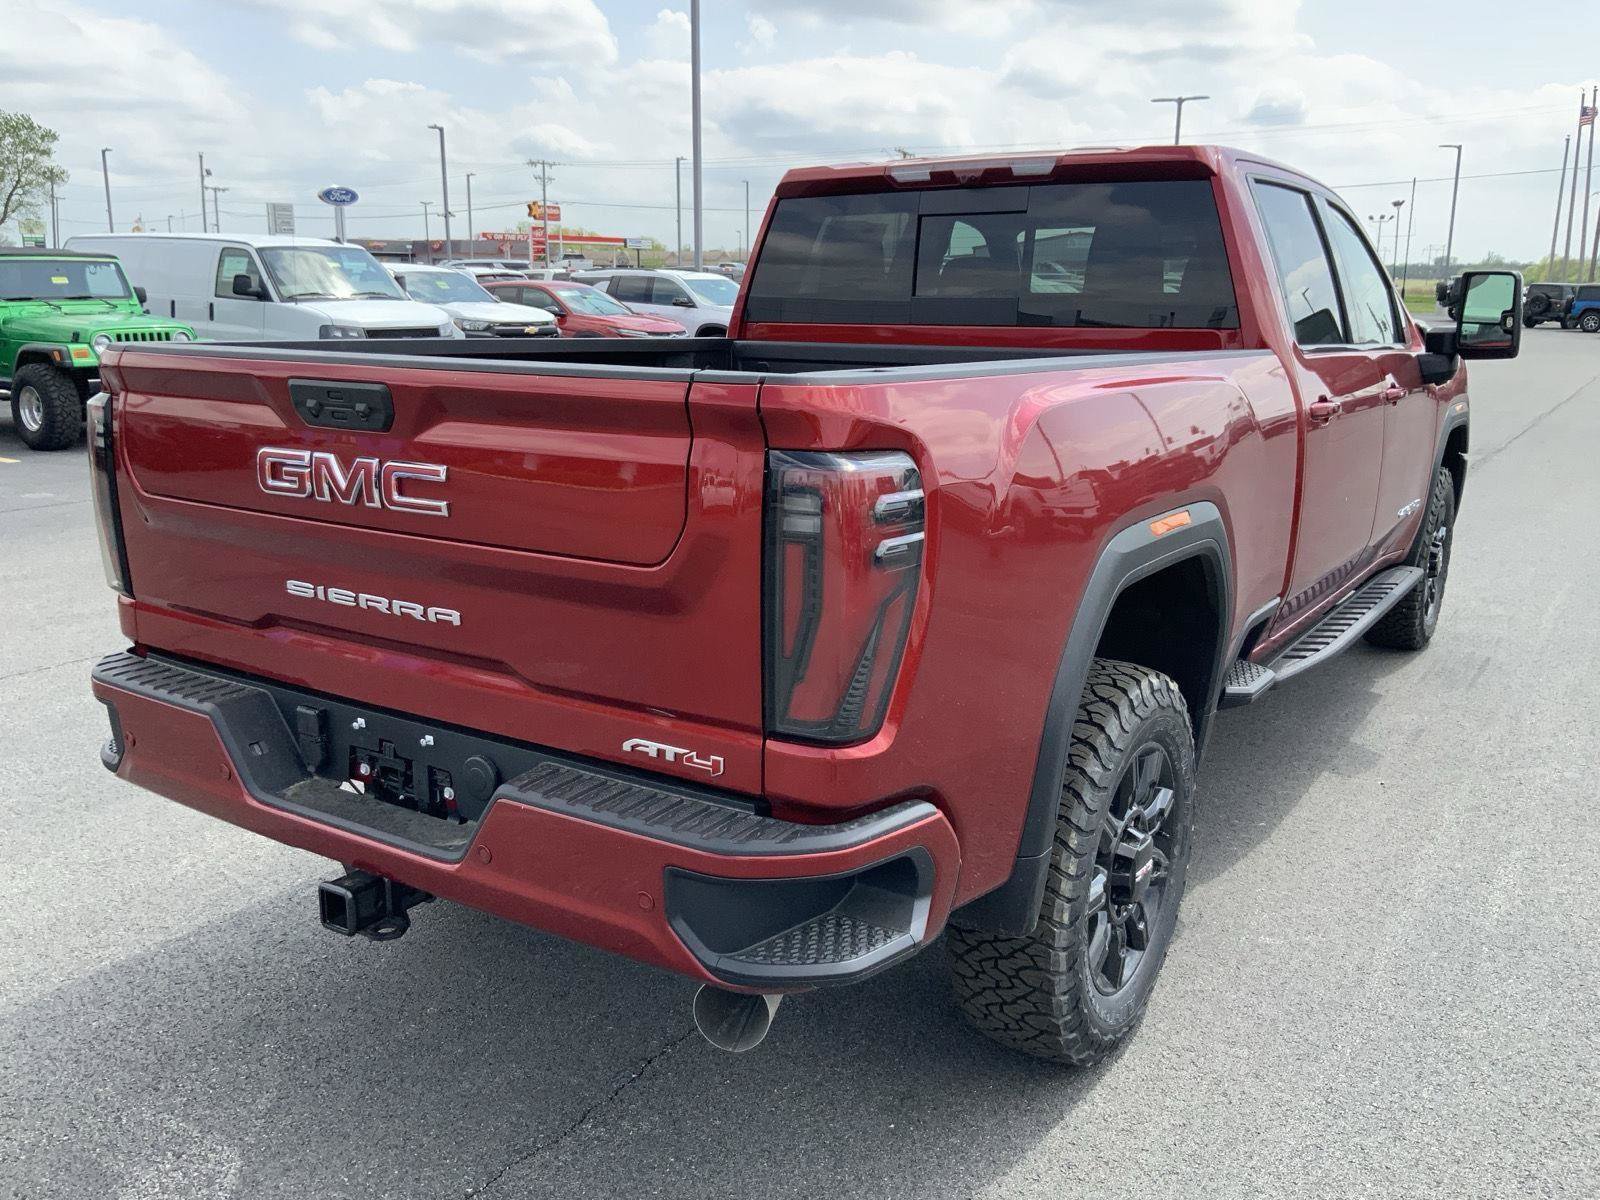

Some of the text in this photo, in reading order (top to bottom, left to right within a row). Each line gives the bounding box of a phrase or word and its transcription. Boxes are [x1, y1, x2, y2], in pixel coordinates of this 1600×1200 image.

[329, 190, 352, 202] Ford
[256, 446, 449, 518] GMC
[286, 579, 462, 626] SIERRA
[622, 738, 725, 777] AT4
